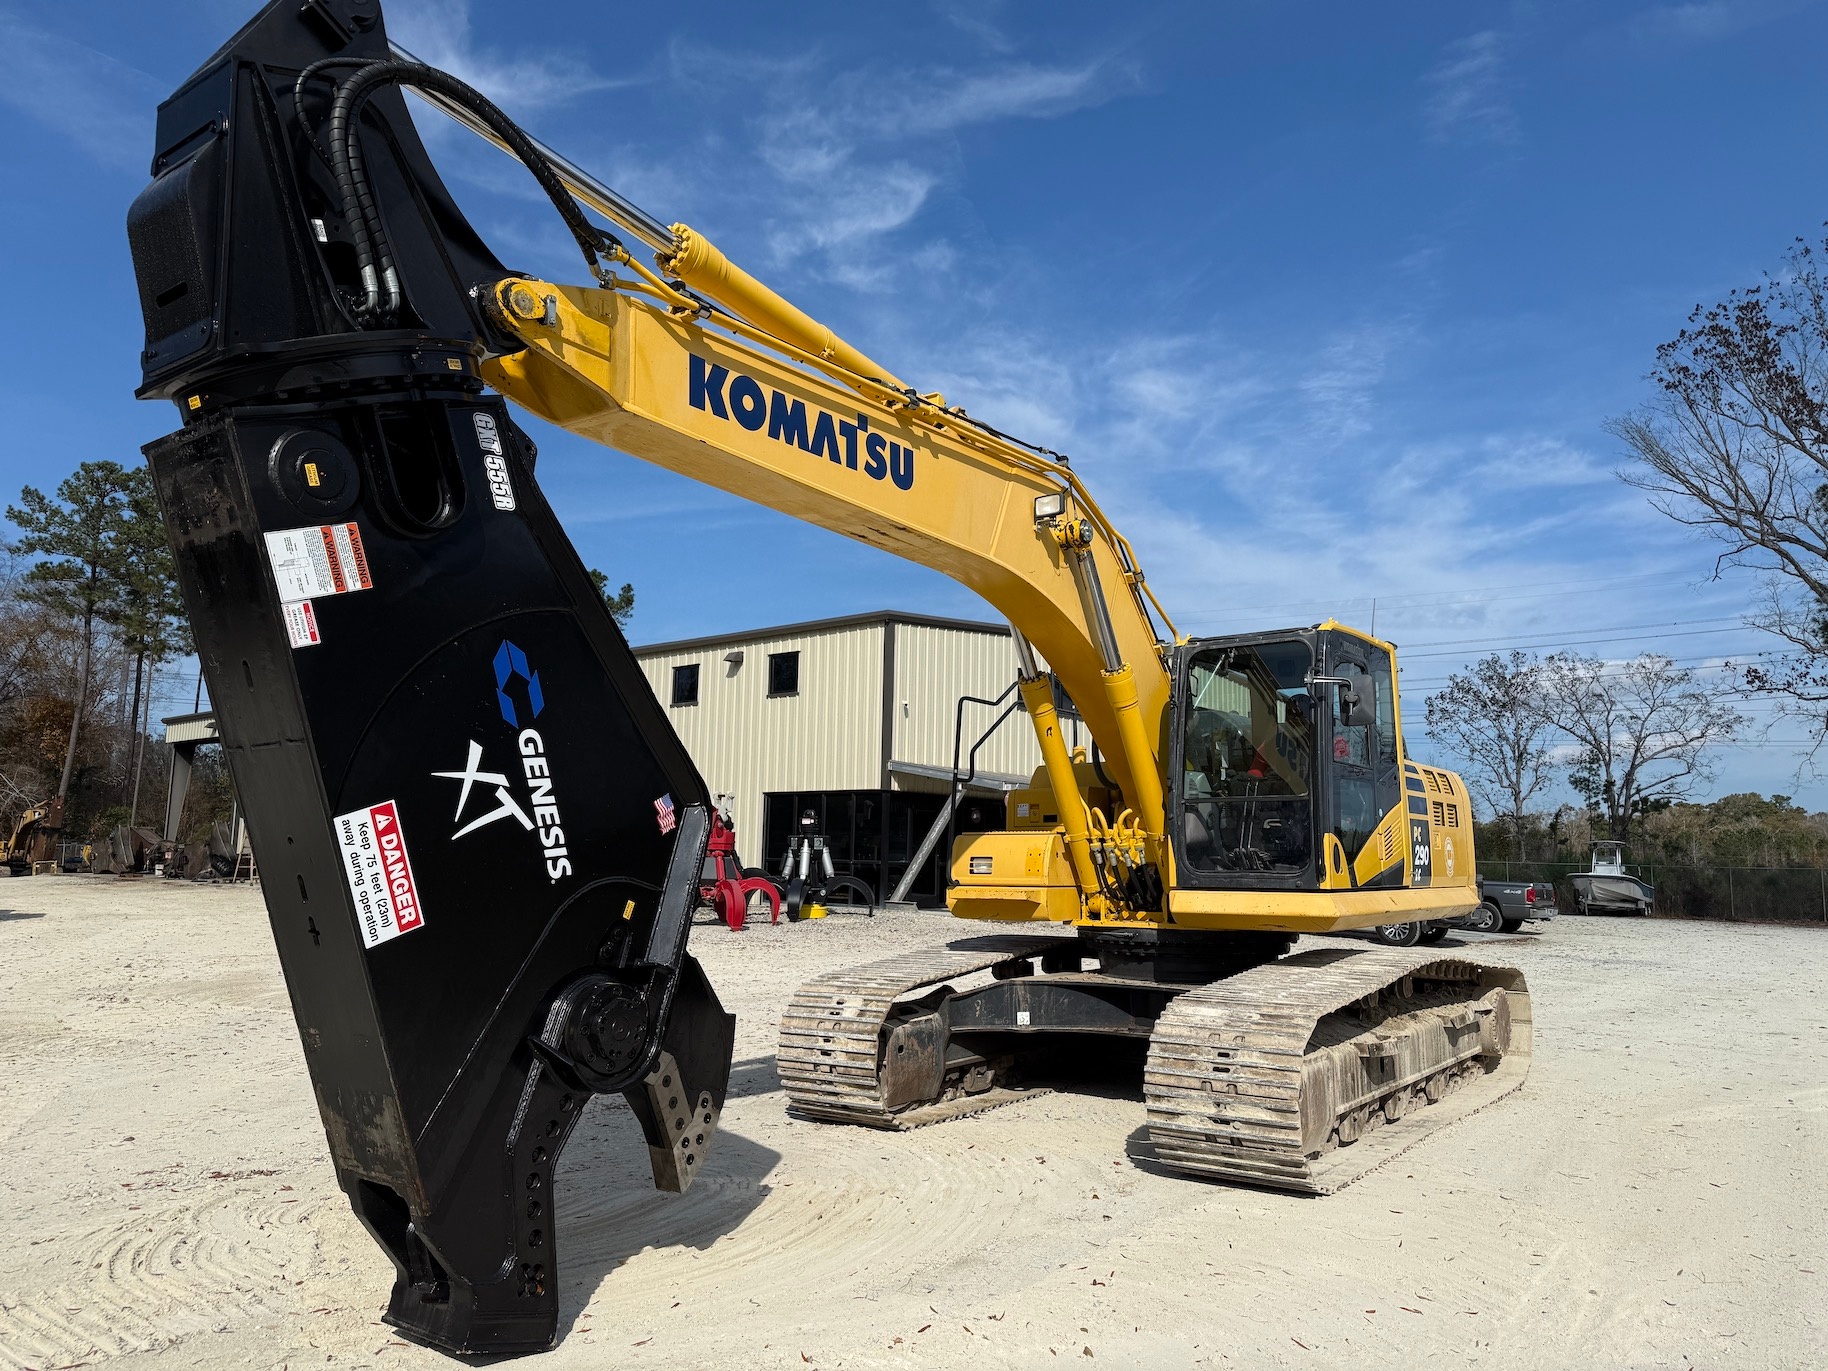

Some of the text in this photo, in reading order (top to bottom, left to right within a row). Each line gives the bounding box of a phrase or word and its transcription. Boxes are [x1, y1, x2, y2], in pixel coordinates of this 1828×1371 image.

[473, 412, 516, 512] GXT 555R
[689, 352, 914, 491] KOMATSU
[325, 540, 344, 588] WARNING
[350, 537, 369, 585] WARNING
[306, 612, 314, 632] NOTICE
[431, 739, 535, 840] XT
[518, 728, 572, 880] GENESIS
[1413, 826, 1422, 842] PC
[342, 819, 379, 942] away during operation
[358, 821, 393, 928] Keep 75 feet (23m)
[380, 832, 417, 925] DANGER
[1414, 844, 1429, 866] 290
